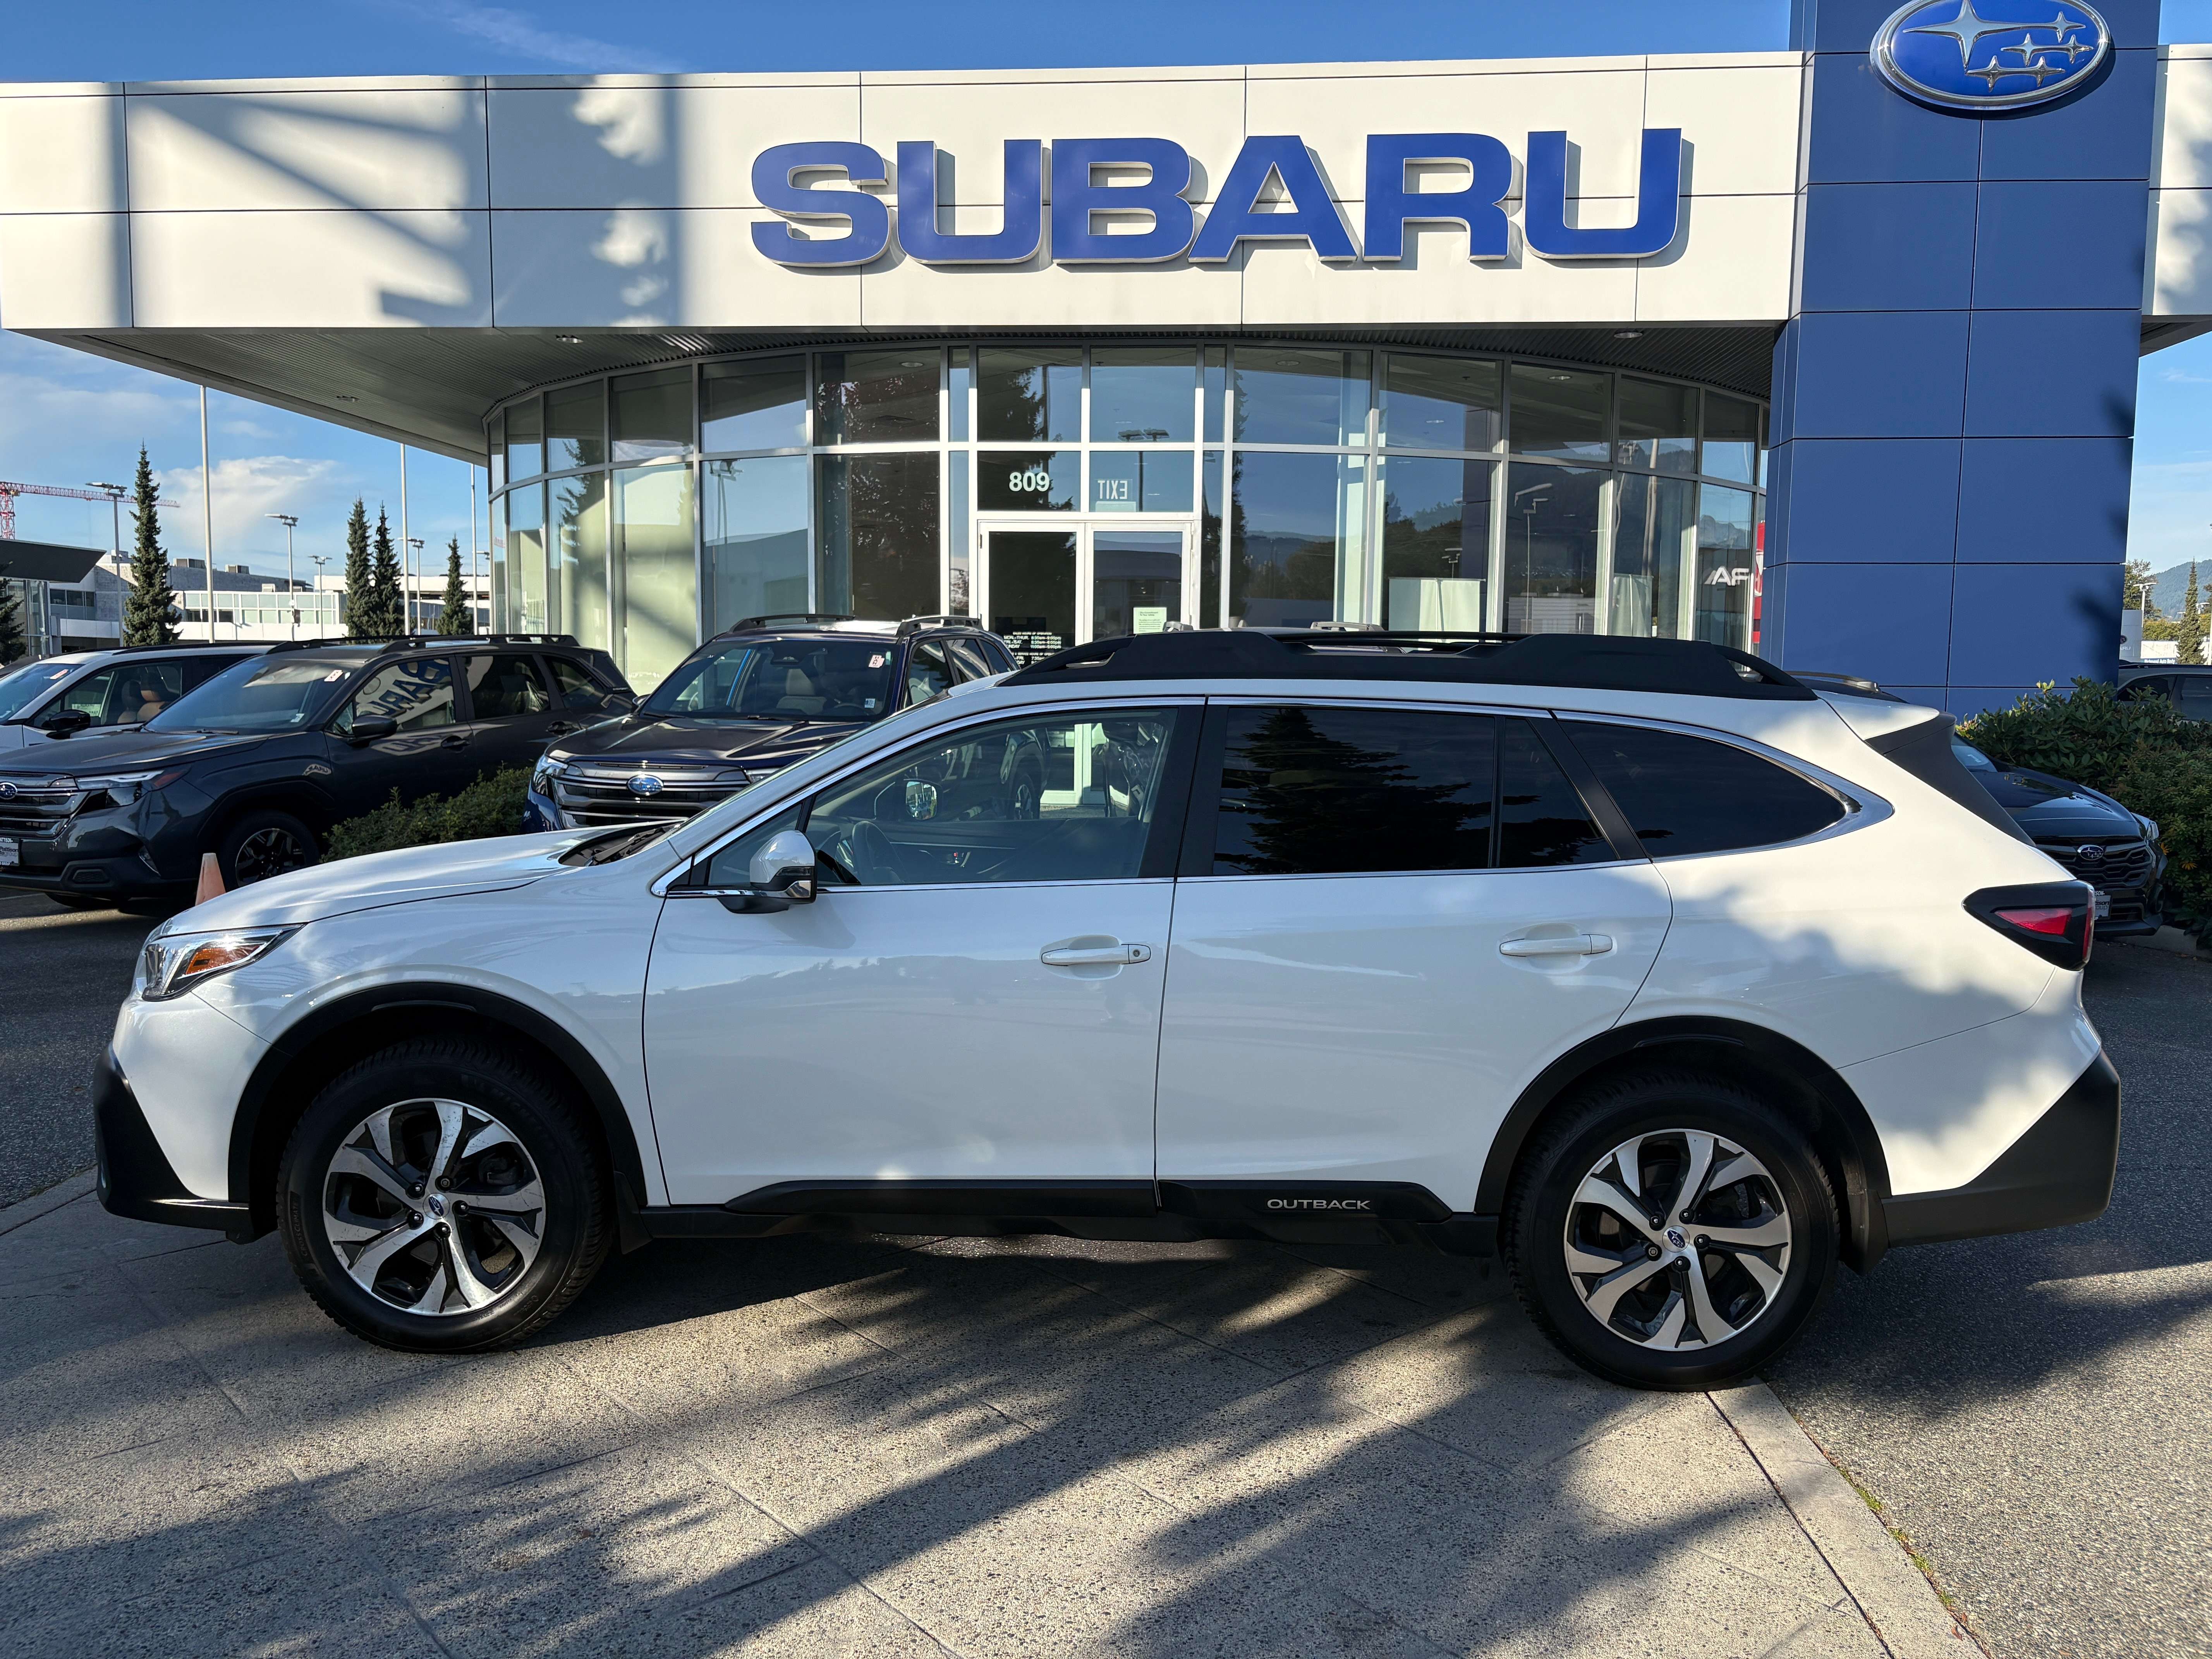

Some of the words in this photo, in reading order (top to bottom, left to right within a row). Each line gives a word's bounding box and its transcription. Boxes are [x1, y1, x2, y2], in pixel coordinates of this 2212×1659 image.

[751, 128, 1683, 267] SUBARU
[1009, 472, 1050, 492] 809
[1267, 1199, 1370, 1210] OUTBACK
